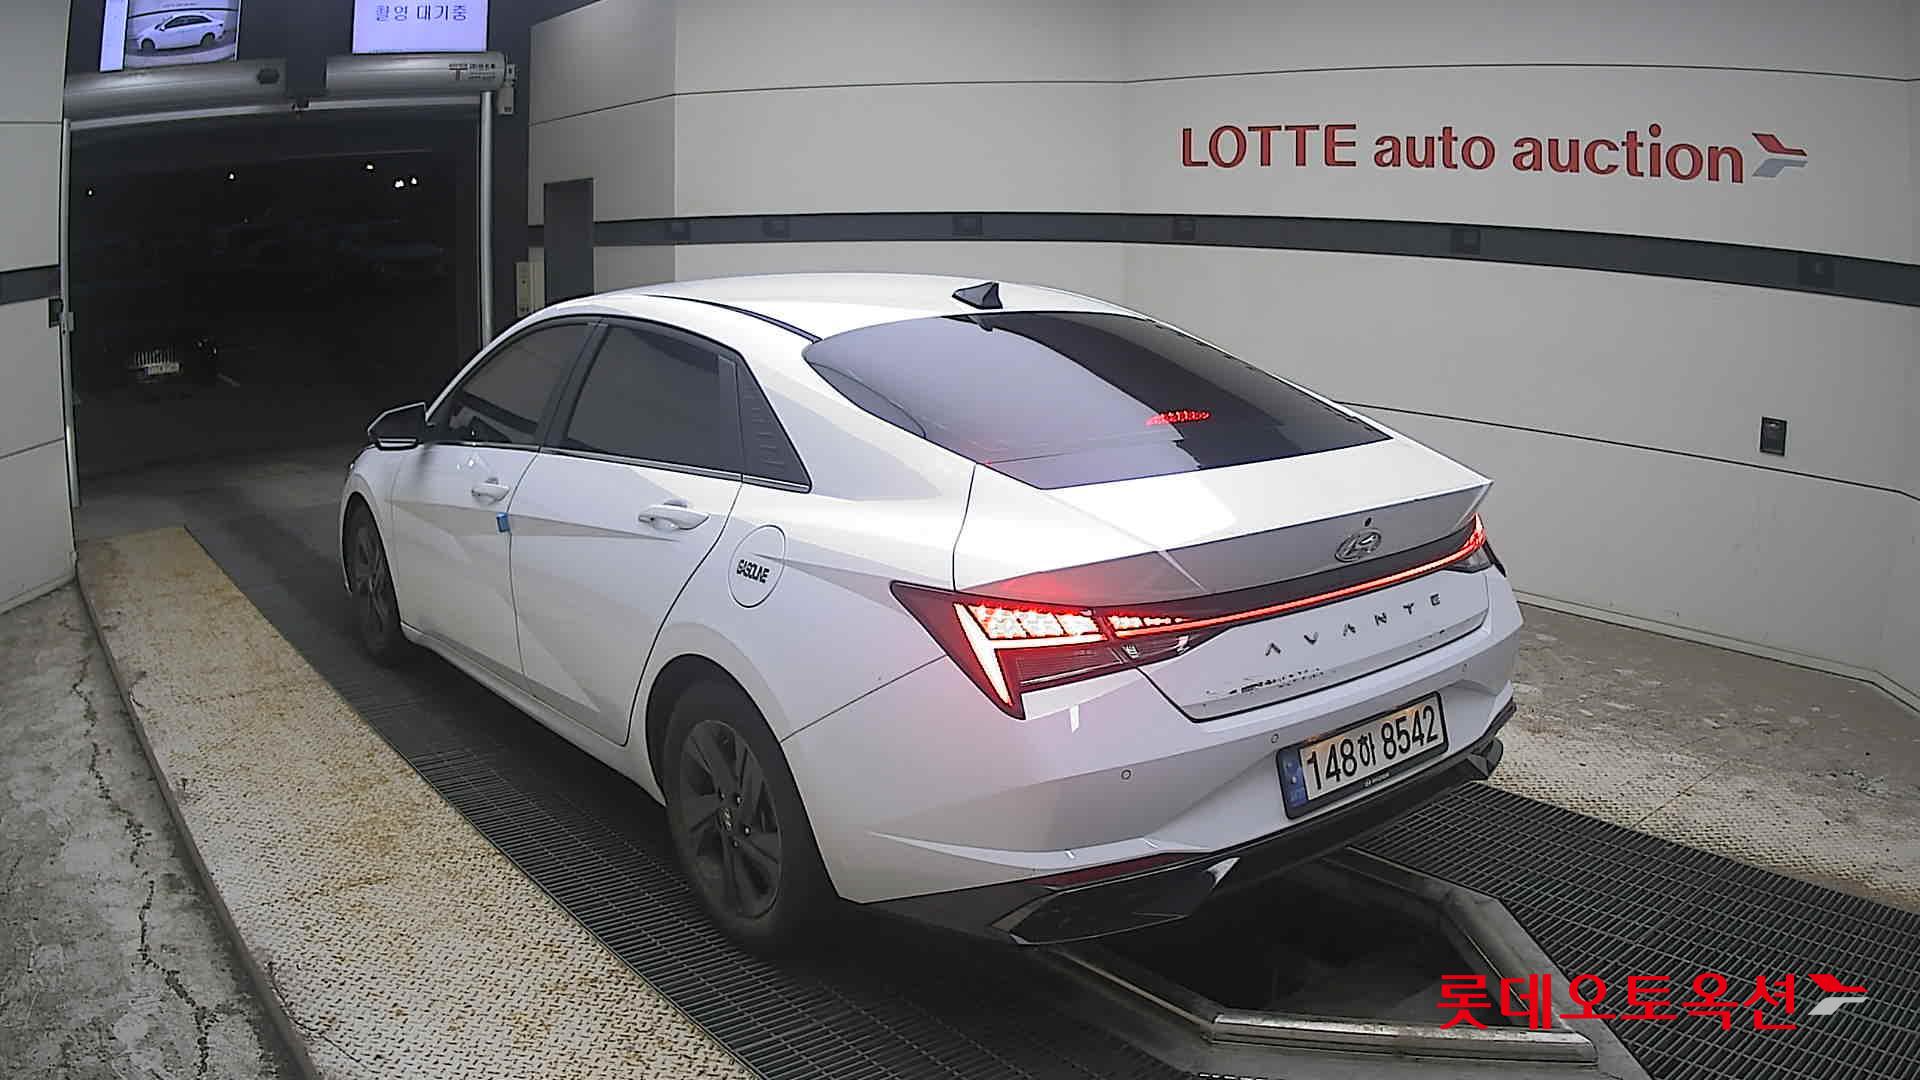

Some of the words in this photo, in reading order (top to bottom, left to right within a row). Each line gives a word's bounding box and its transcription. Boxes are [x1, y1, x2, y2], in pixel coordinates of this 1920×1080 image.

[416, 4, 467, 21] 대기중
[1182, 123, 1357, 168] LOTTE
[1374, 126, 1496, 169] auto
[1512, 123, 1745, 184] auction
[1264, 593, 1442, 656] AVANTE
[1306, 732, 1377, 790] 148하
[1381, 705, 1439, 760] 8542
